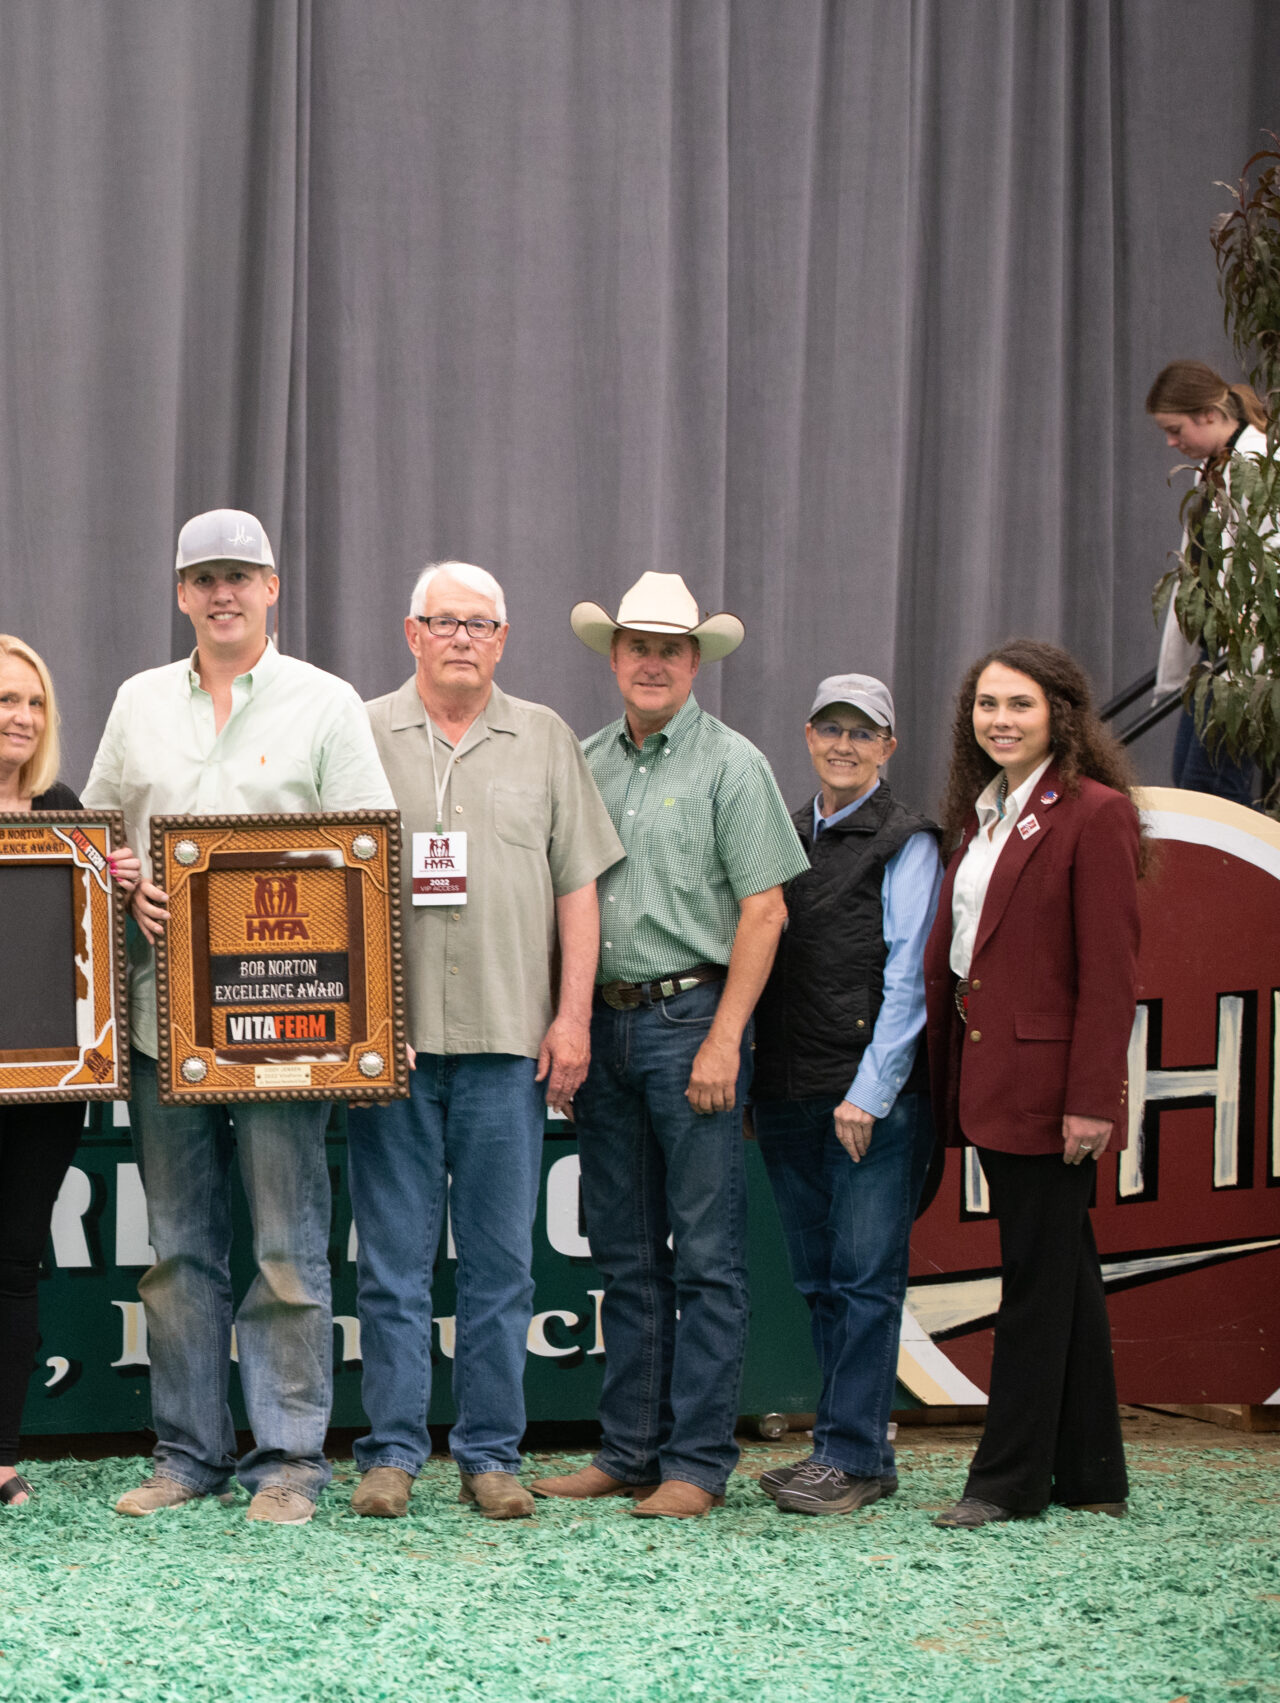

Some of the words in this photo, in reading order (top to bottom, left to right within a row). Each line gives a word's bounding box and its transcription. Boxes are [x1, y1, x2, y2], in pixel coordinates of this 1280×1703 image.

[8, 829, 44, 840] NORTON
[31, 842, 65, 853] AWARD
[424, 859, 454, 868] HYFA
[246, 919, 310, 941] HYFA
[240, 961, 265, 977] BOB
[269, 959, 317, 976] NORTON
[215, 983, 294, 1000] EXCELLENCE
[297, 980, 344, 998] AWARD
[229, 1014, 326, 1041] VITAFERM
